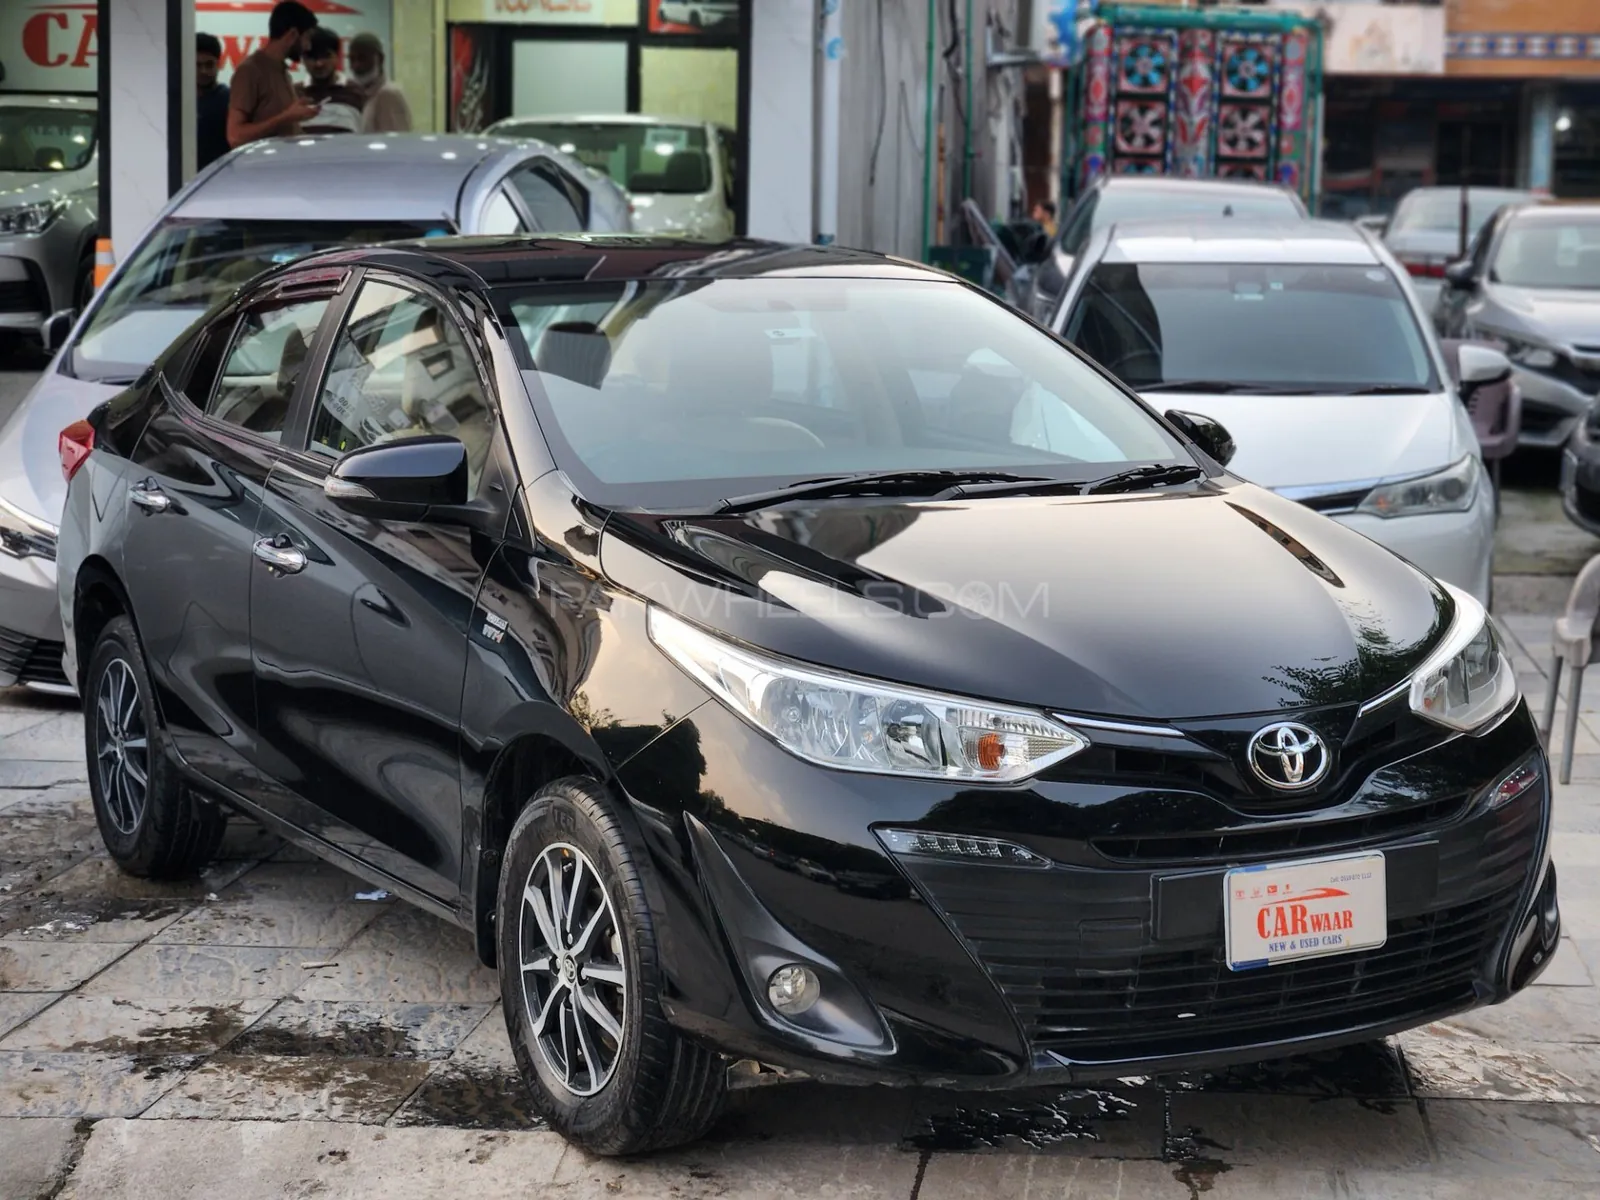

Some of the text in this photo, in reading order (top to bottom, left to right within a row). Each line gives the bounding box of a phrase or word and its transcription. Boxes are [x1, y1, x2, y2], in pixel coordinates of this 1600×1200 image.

[22, 13, 98, 68] CA
[1257, 904, 1353, 939] CAR WAAR
[1268, 934, 1343, 953] NEW & USED CARS
